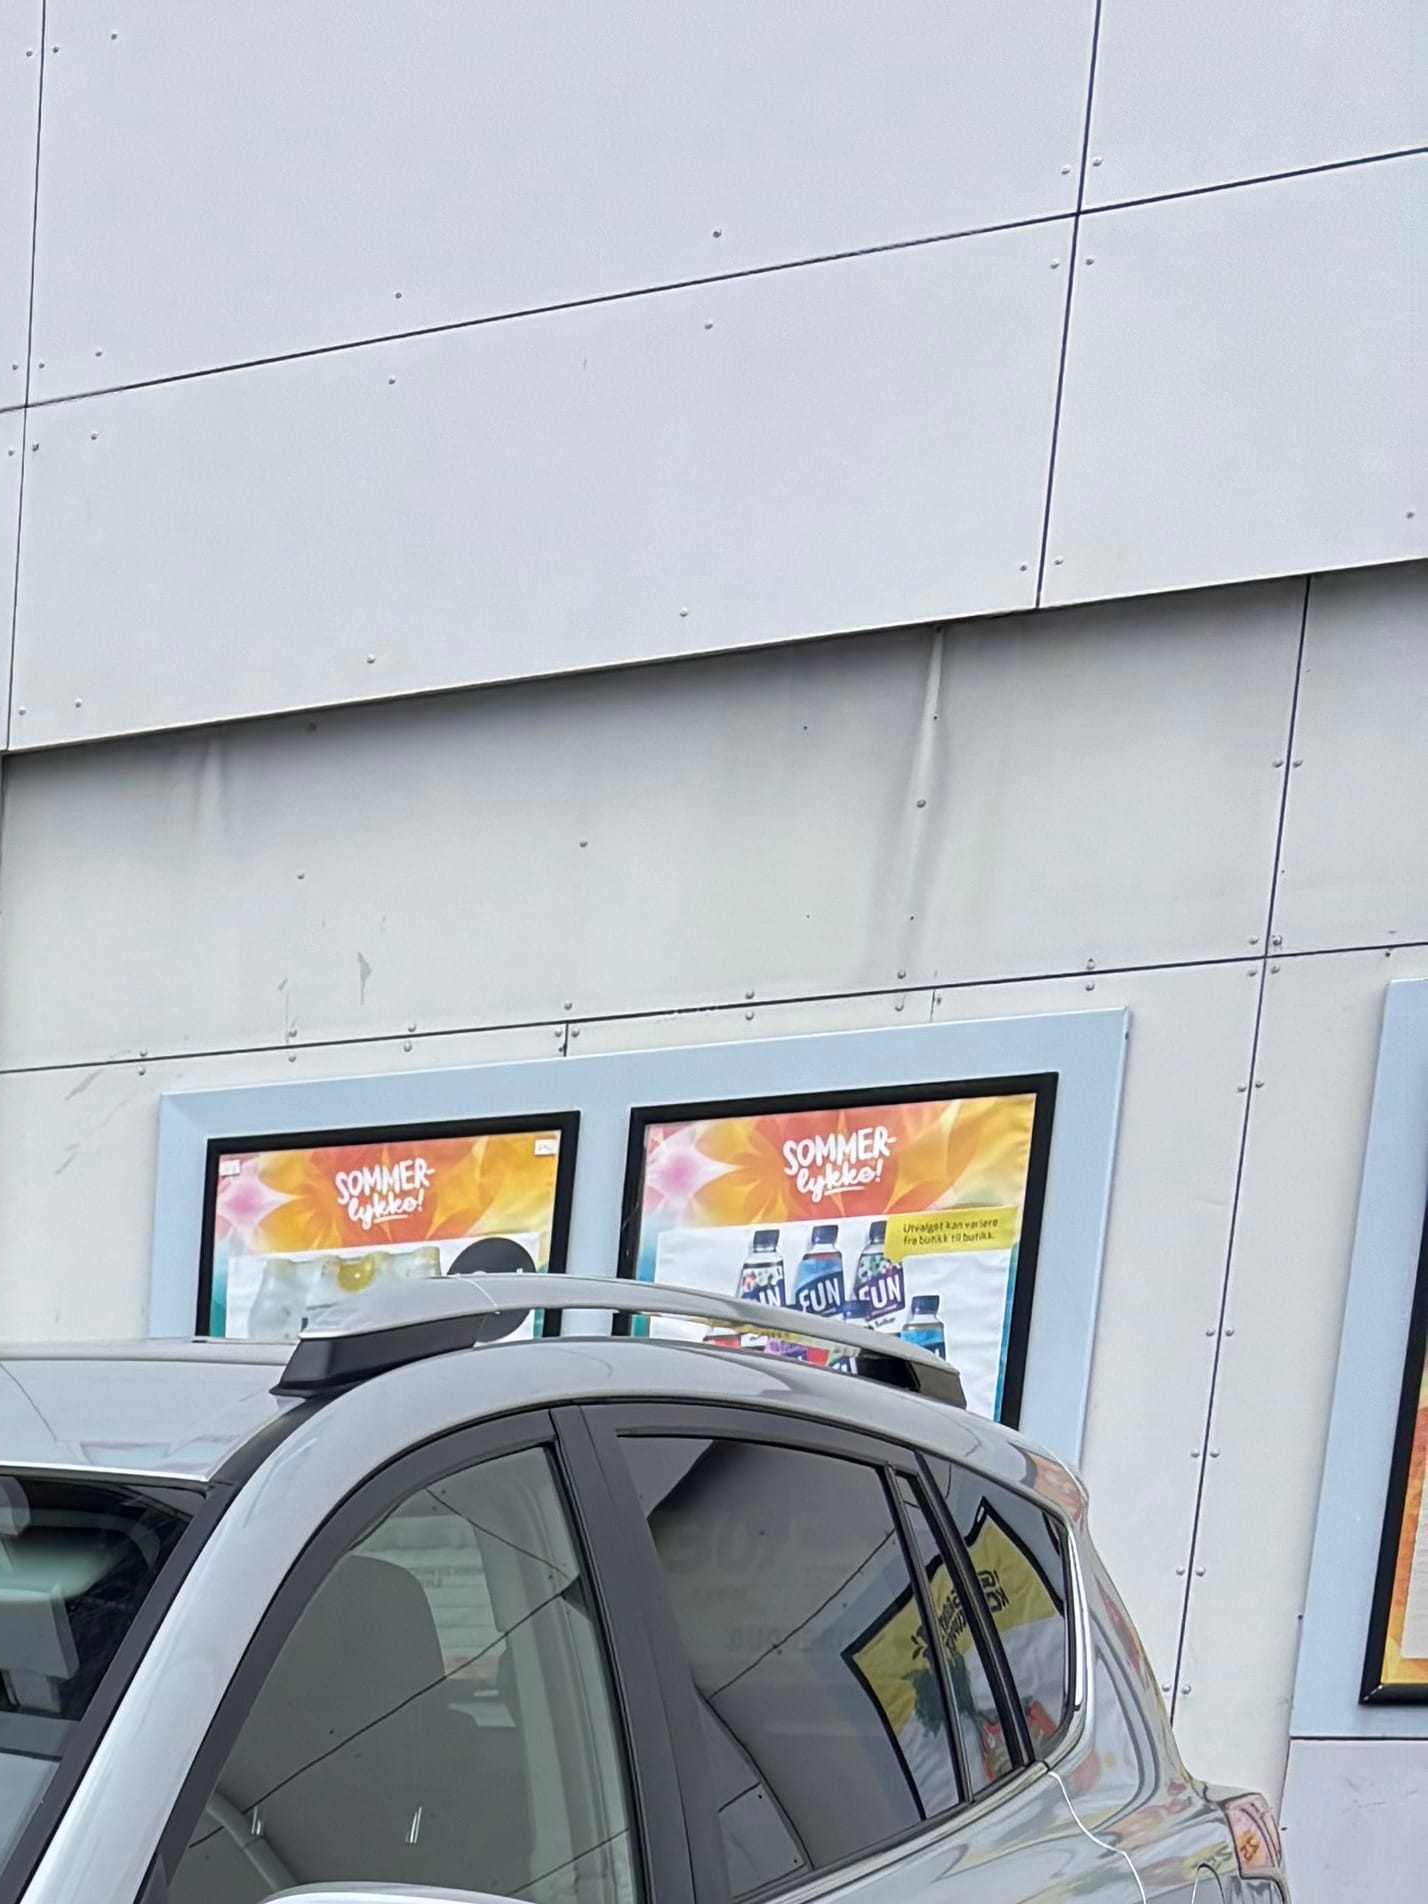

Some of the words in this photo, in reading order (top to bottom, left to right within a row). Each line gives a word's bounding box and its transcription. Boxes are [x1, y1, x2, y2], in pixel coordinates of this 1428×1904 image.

[783, 1126, 896, 1176] SOMMER-
[335, 1157, 436, 1206] SOMMER-
[796, 1160, 883, 1203] lykke!
[946, 1221, 963, 1230] kan
[799, 1278, 841, 1312] FUN
[858, 1275, 901, 1309] FUN
